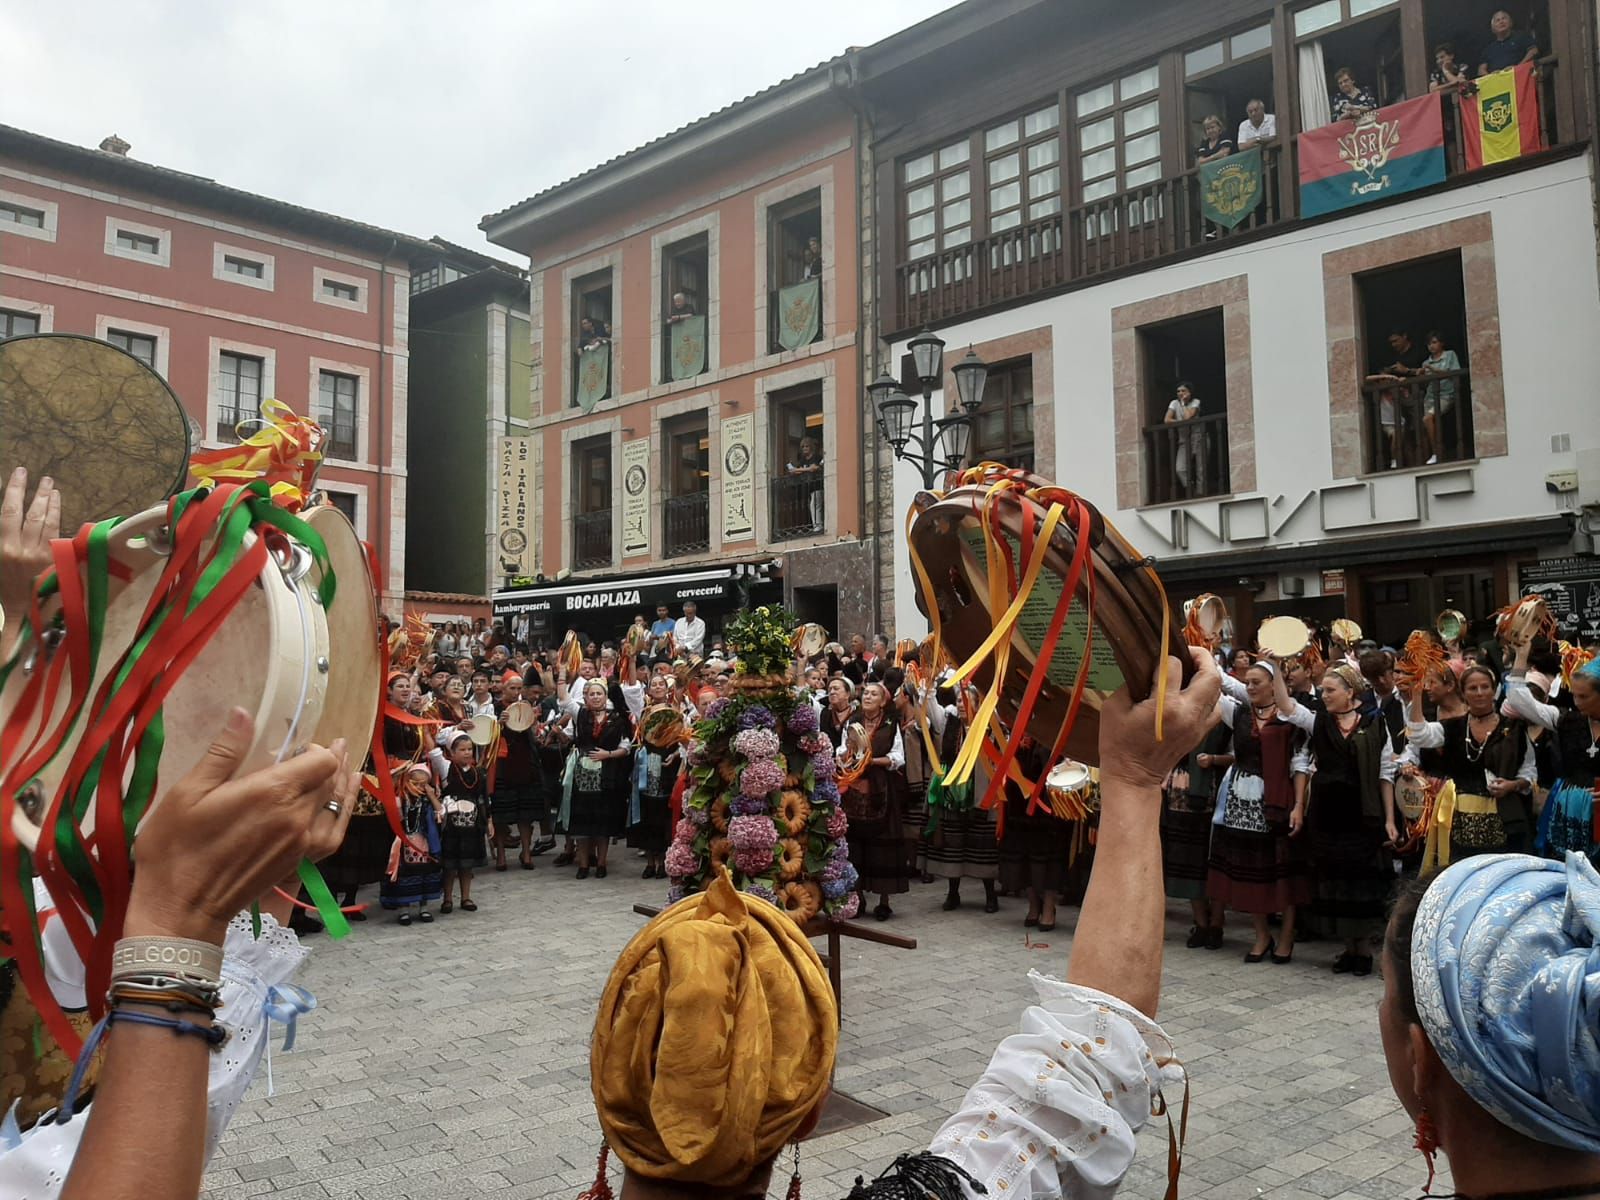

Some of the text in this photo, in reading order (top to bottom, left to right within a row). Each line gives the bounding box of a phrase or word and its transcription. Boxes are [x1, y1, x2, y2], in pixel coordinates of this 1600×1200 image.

[503, 441, 512, 477] PASTA
[517, 441, 527, 528] LOS ITALIANOS
[501, 490, 511, 526] PIZZA
[566, 590, 641, 610] BOCAPLAZA
[676, 584, 723, 598] cervecería
[495, 600, 550, 614] hamburguesería
